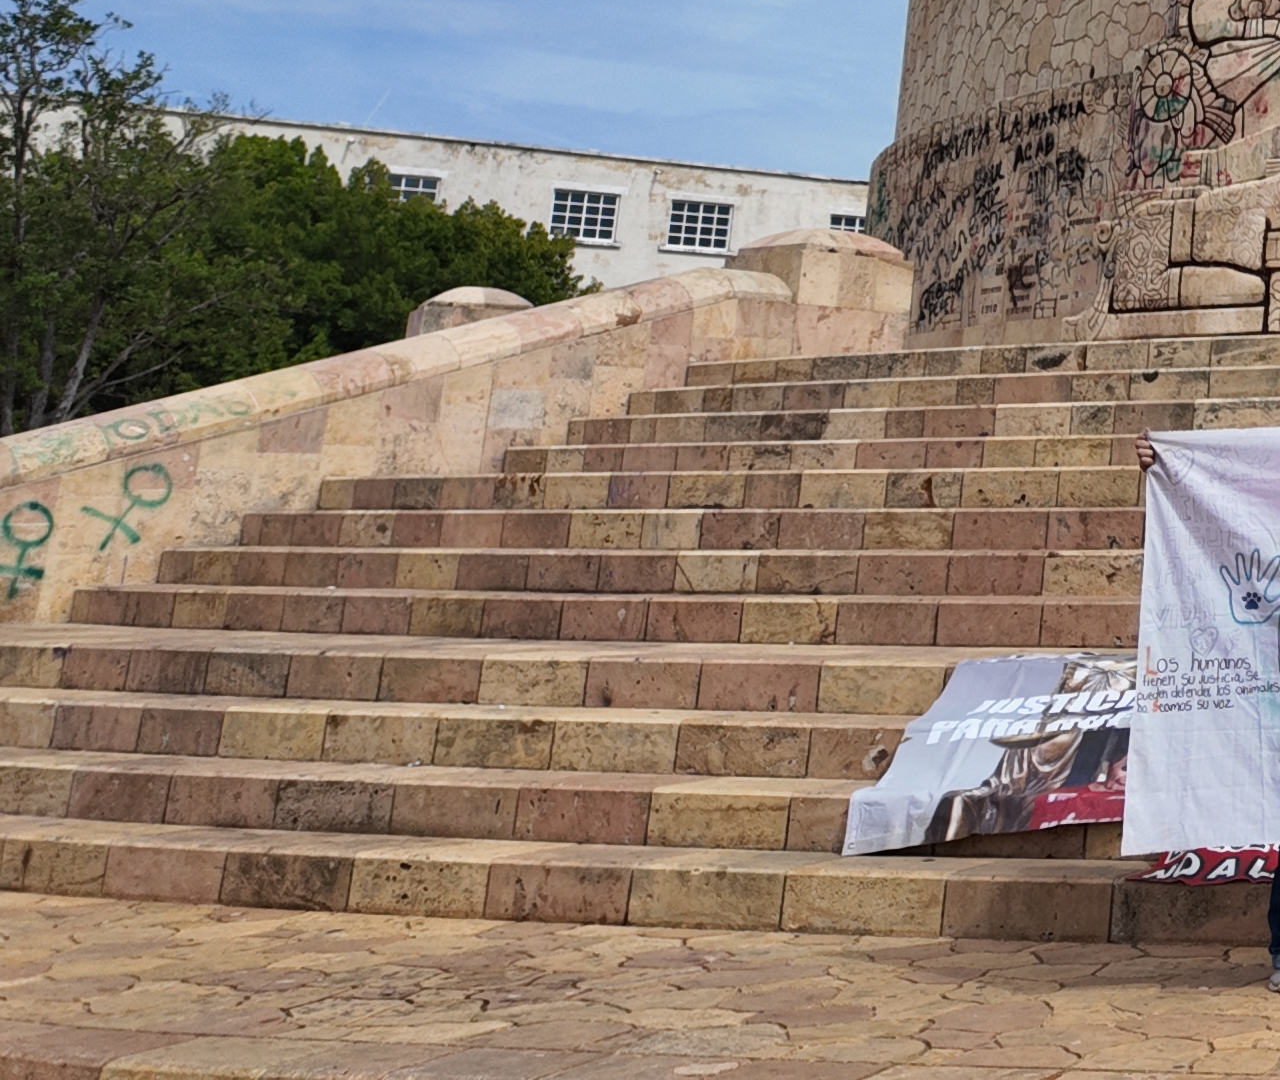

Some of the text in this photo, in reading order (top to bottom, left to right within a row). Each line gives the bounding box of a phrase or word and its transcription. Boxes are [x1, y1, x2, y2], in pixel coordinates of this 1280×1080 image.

[1146, 646, 1252, 675] Los humanos
[926, 718, 1041, 745] PARA
